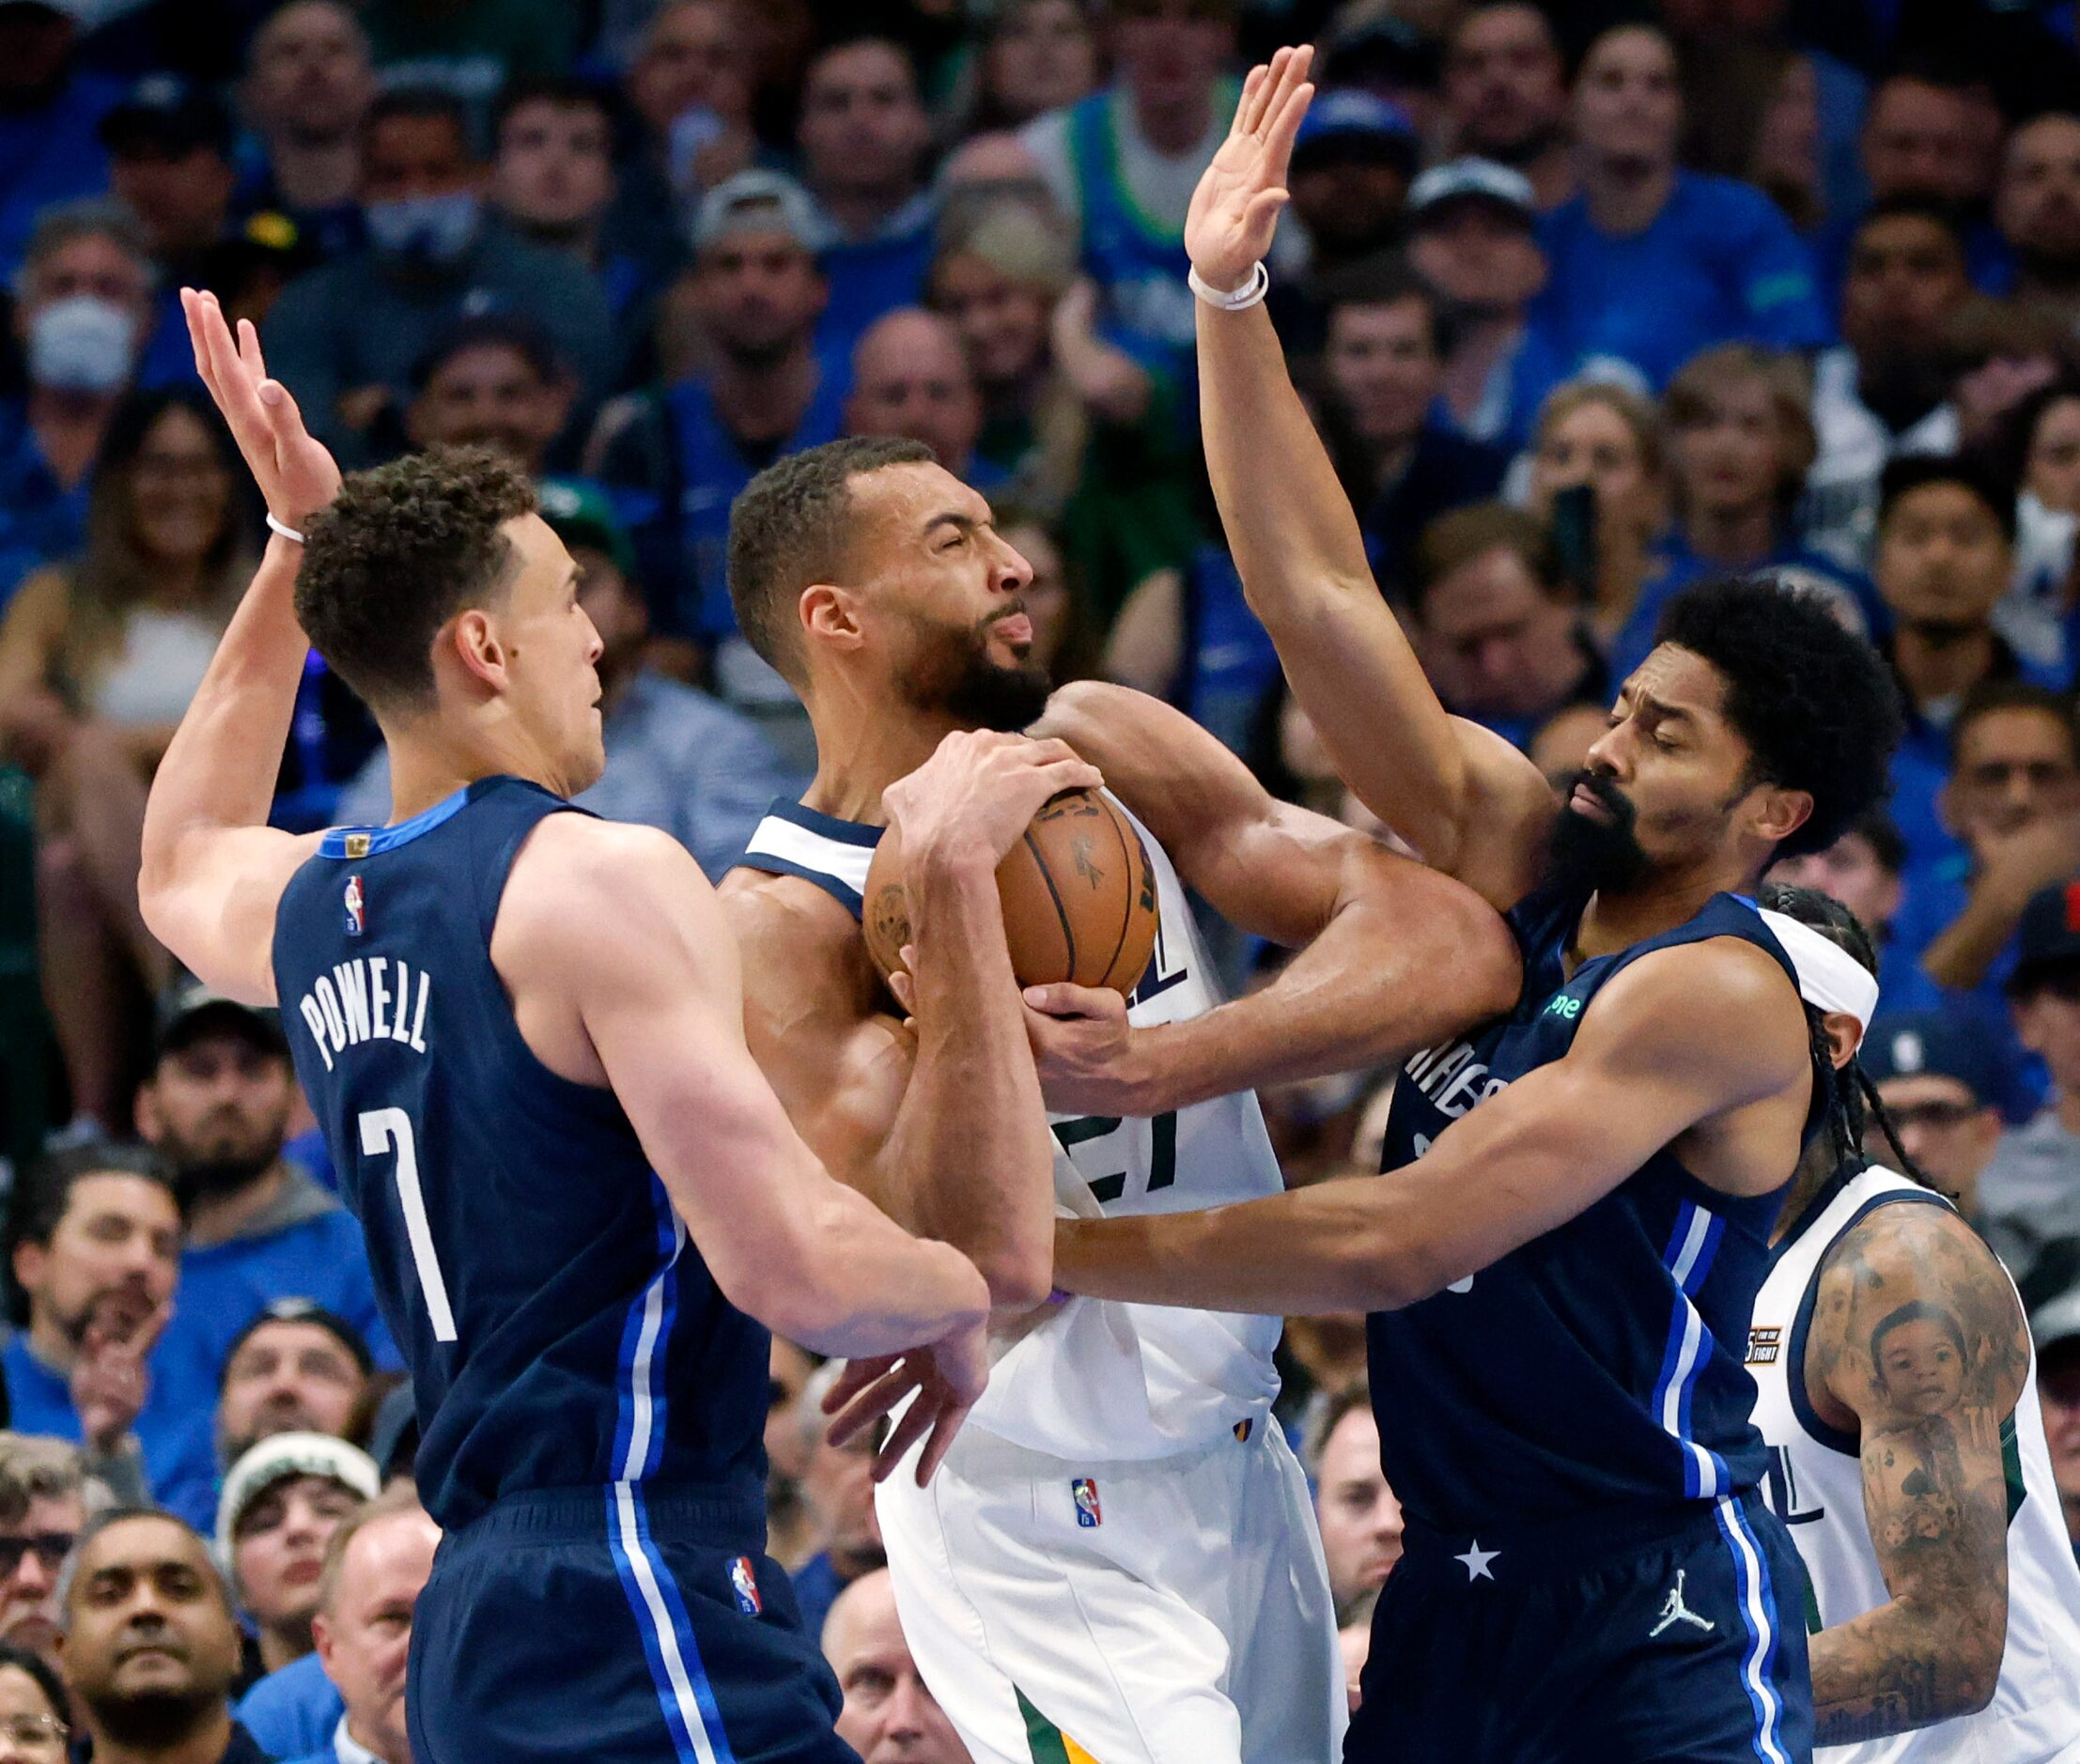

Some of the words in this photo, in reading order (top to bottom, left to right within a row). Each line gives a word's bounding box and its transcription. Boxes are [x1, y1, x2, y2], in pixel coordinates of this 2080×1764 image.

[300, 956, 430, 1073] POWELL
[358, 1106, 458, 1342] 7
[1753, 1346, 1777, 1362] FIGHT
